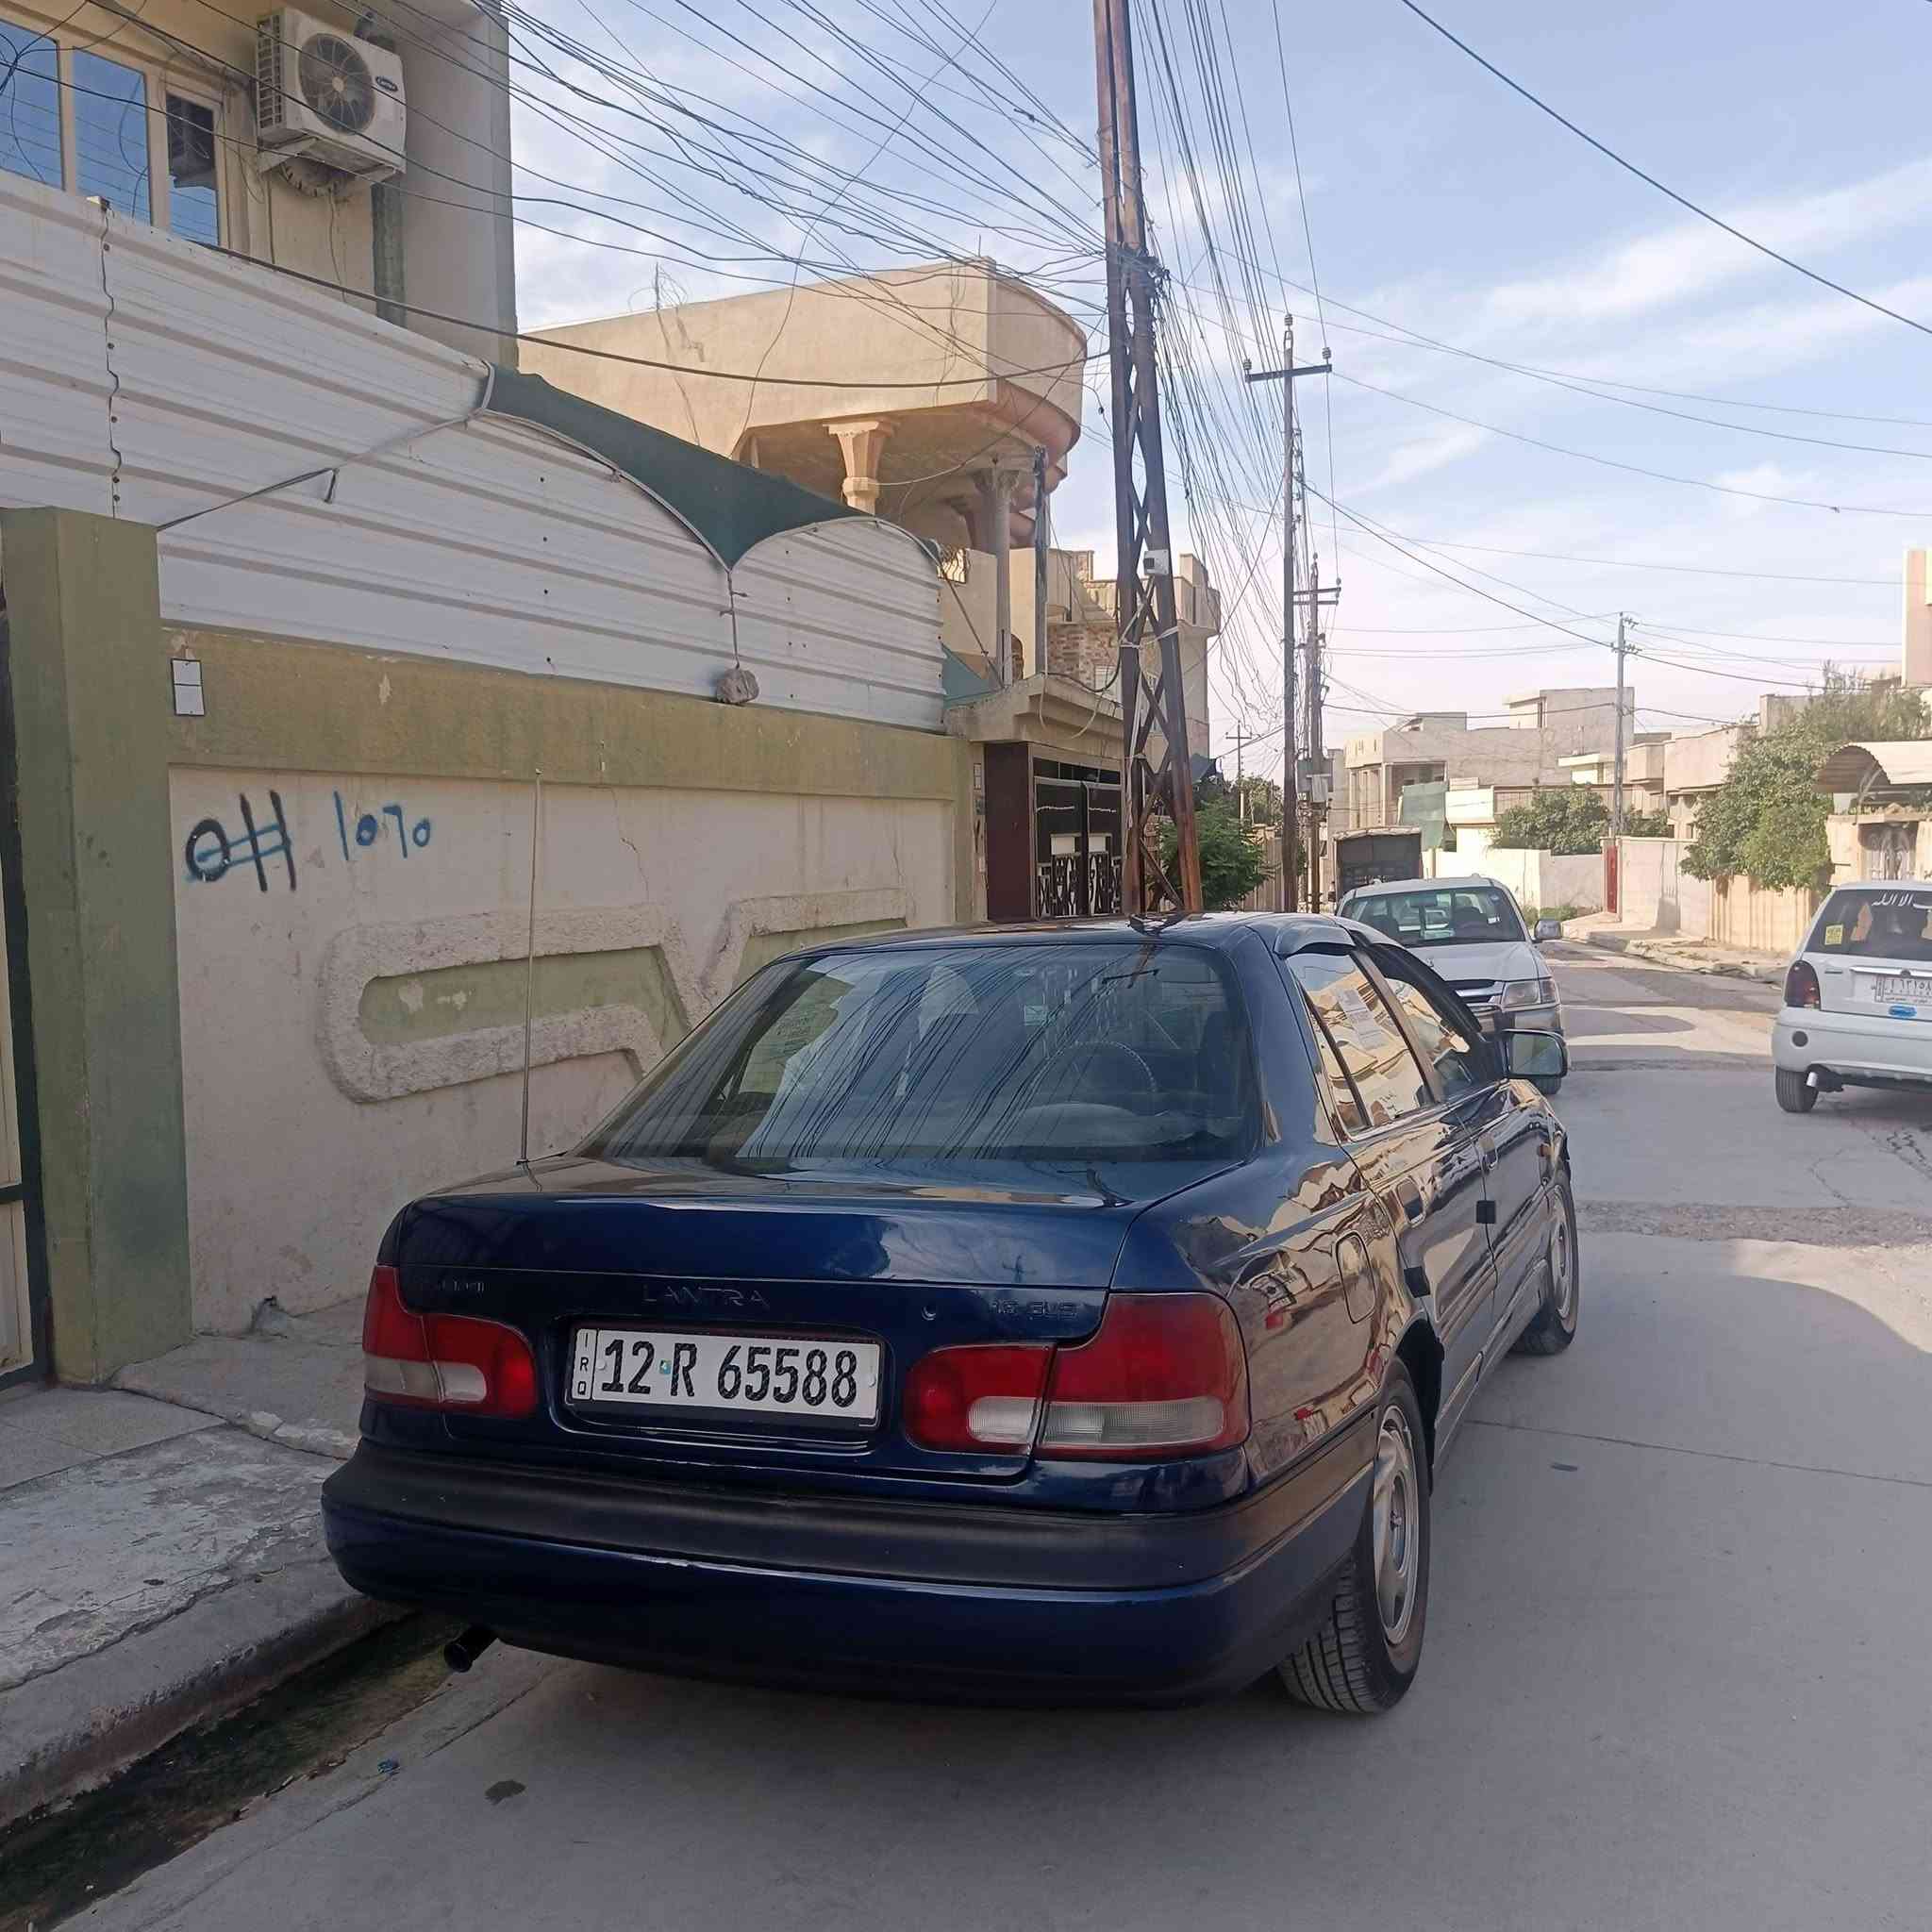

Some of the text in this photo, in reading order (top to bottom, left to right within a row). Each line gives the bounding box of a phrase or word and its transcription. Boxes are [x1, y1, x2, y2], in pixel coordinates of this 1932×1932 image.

[601, 1339, 858, 1408] 12 R 65588
